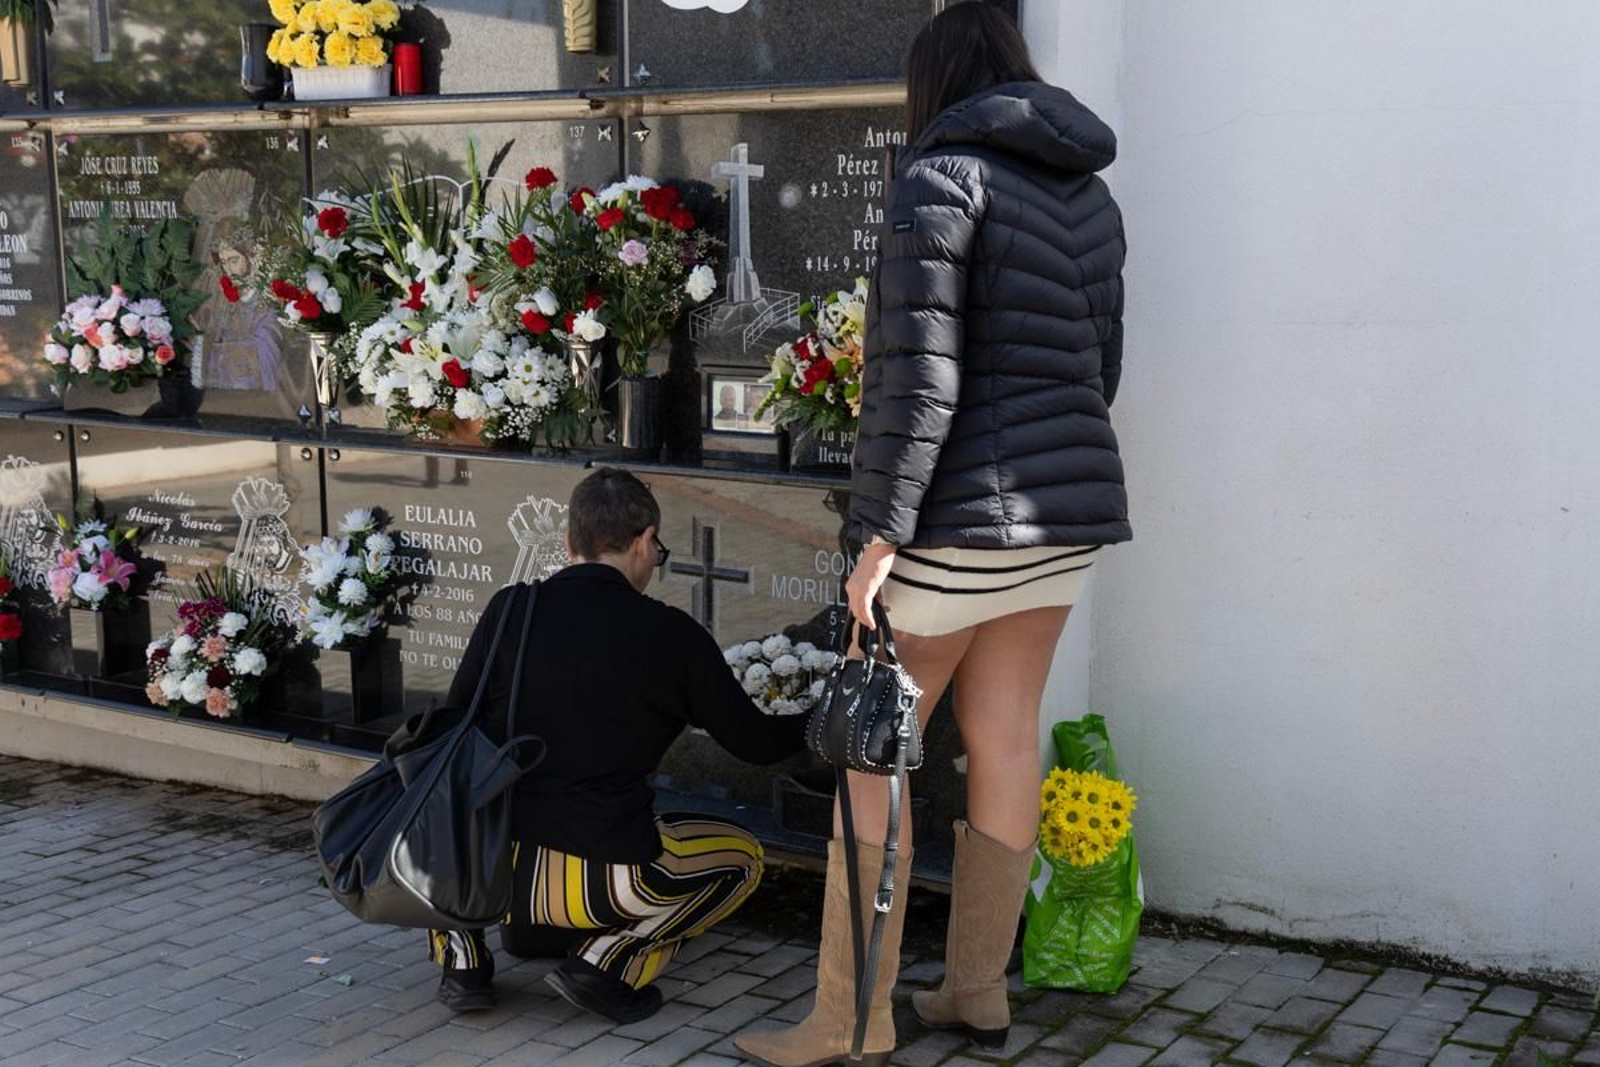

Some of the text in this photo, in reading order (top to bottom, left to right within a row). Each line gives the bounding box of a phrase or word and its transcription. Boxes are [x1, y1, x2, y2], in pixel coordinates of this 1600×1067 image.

[569, 125, 585, 138] 137
[104, 155, 128, 175] CRUZ
[130, 154, 160, 174] REYES
[836, 153, 878, 176] Pérez
[133, 200, 178, 220] VALENCIA
[863, 202, 885, 224] An
[852, 229, 879, 251] Pér
[818, 445, 850, 464] lleva
[148, 488, 197, 507] Nicolás
[125, 506, 225, 533] Ibáñez García
[404, 503, 477, 529] EULALIA
[400, 529, 483, 556] SERRANO
[390, 554, 493, 583] REGALAJAR
[814, 549, 857, 577] GON
[771, 574, 848, 607] MORILL
[393, 601, 403, 615] A
[406, 603, 432, 619] LOS
[436, 607, 453, 622] 88
[408, 629, 425, 644] TU
[422, 653, 438, 668] TE
